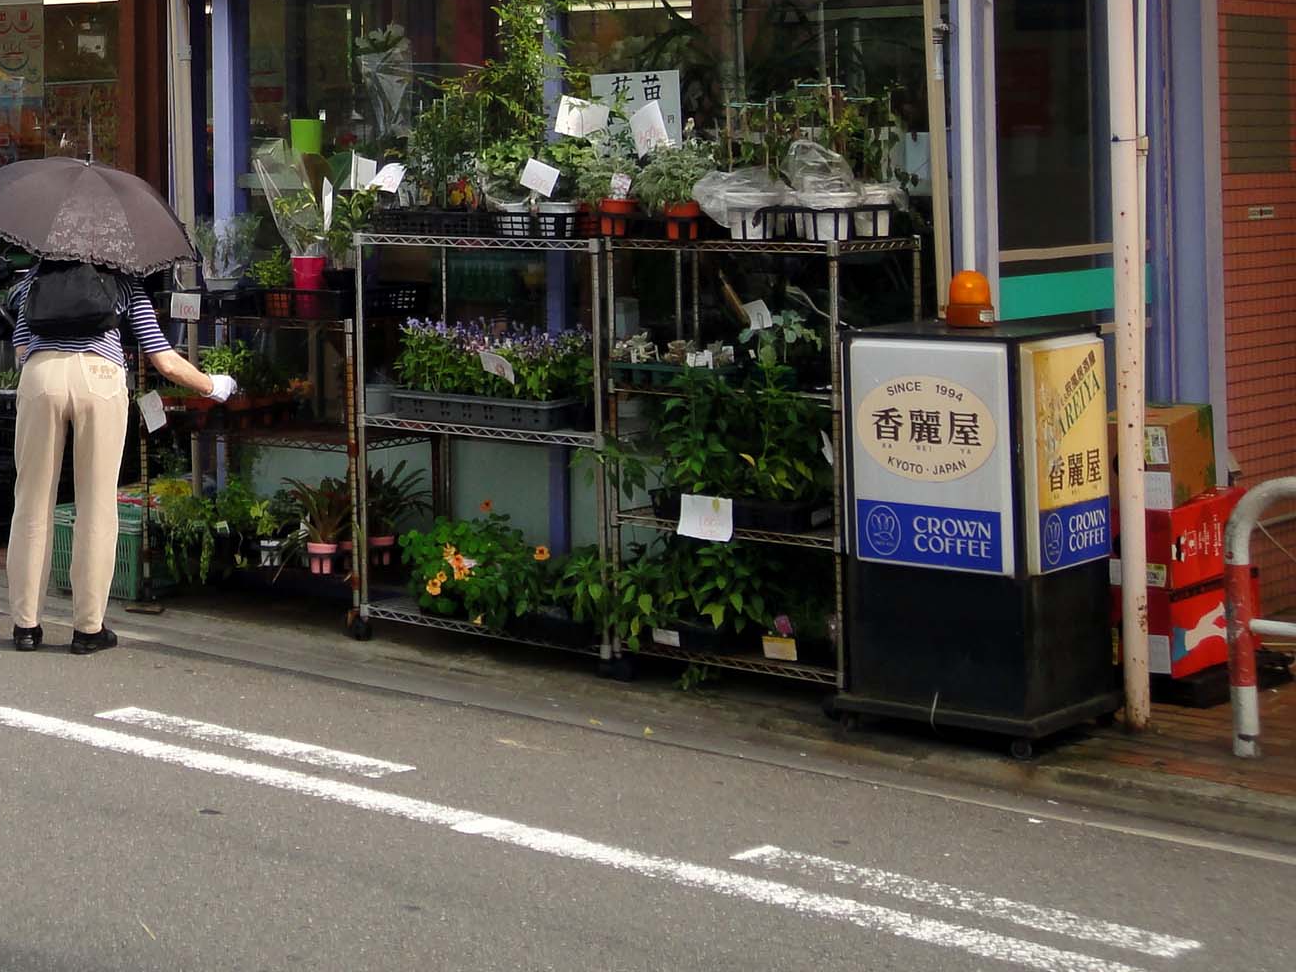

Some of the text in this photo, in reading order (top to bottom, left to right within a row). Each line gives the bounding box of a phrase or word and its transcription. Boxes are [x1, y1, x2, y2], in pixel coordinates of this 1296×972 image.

[887, 382, 963, 402] SINCE 1994
[872, 407, 982, 447] 香麗屋
[888, 456, 967, 475] KYOTO JAPAN
[913, 516, 991, 540] CROWN
[1069, 508, 1105, 533] CROWN
[913, 534, 992, 558] COFFEE
[1069, 527, 1106, 552] COFFEE
